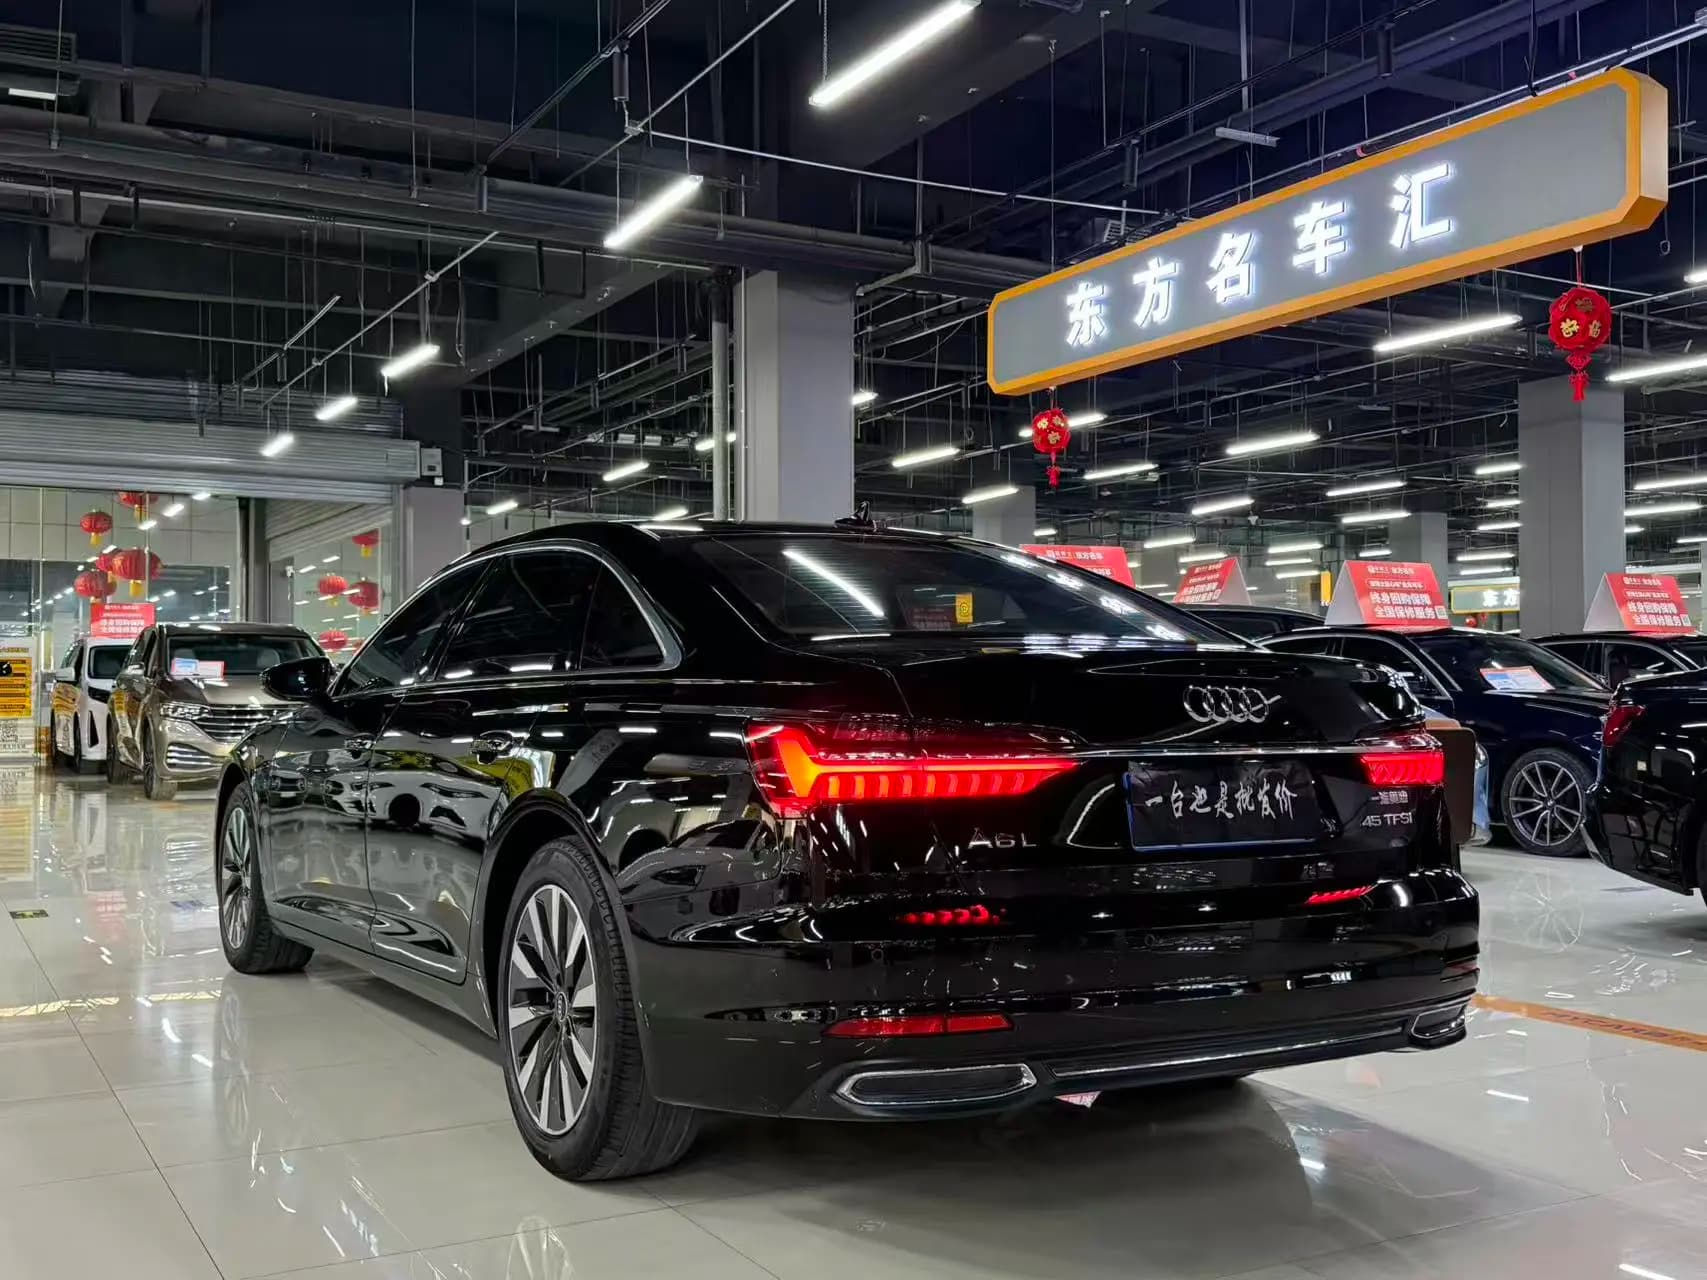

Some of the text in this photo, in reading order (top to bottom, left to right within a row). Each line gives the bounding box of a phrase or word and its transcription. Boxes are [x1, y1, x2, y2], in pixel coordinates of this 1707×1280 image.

[1065, 162, 1452, 347] 东方名车汇
[1369, 591, 1431, 606] 终身回购保障
[1373, 605, 1436, 619] 全国保修服务
[1145, 778, 1298, 820] 一台也是批发价
[1361, 812, 1413, 827] 45 TFSI
[967, 827, 1037, 849] A6L
